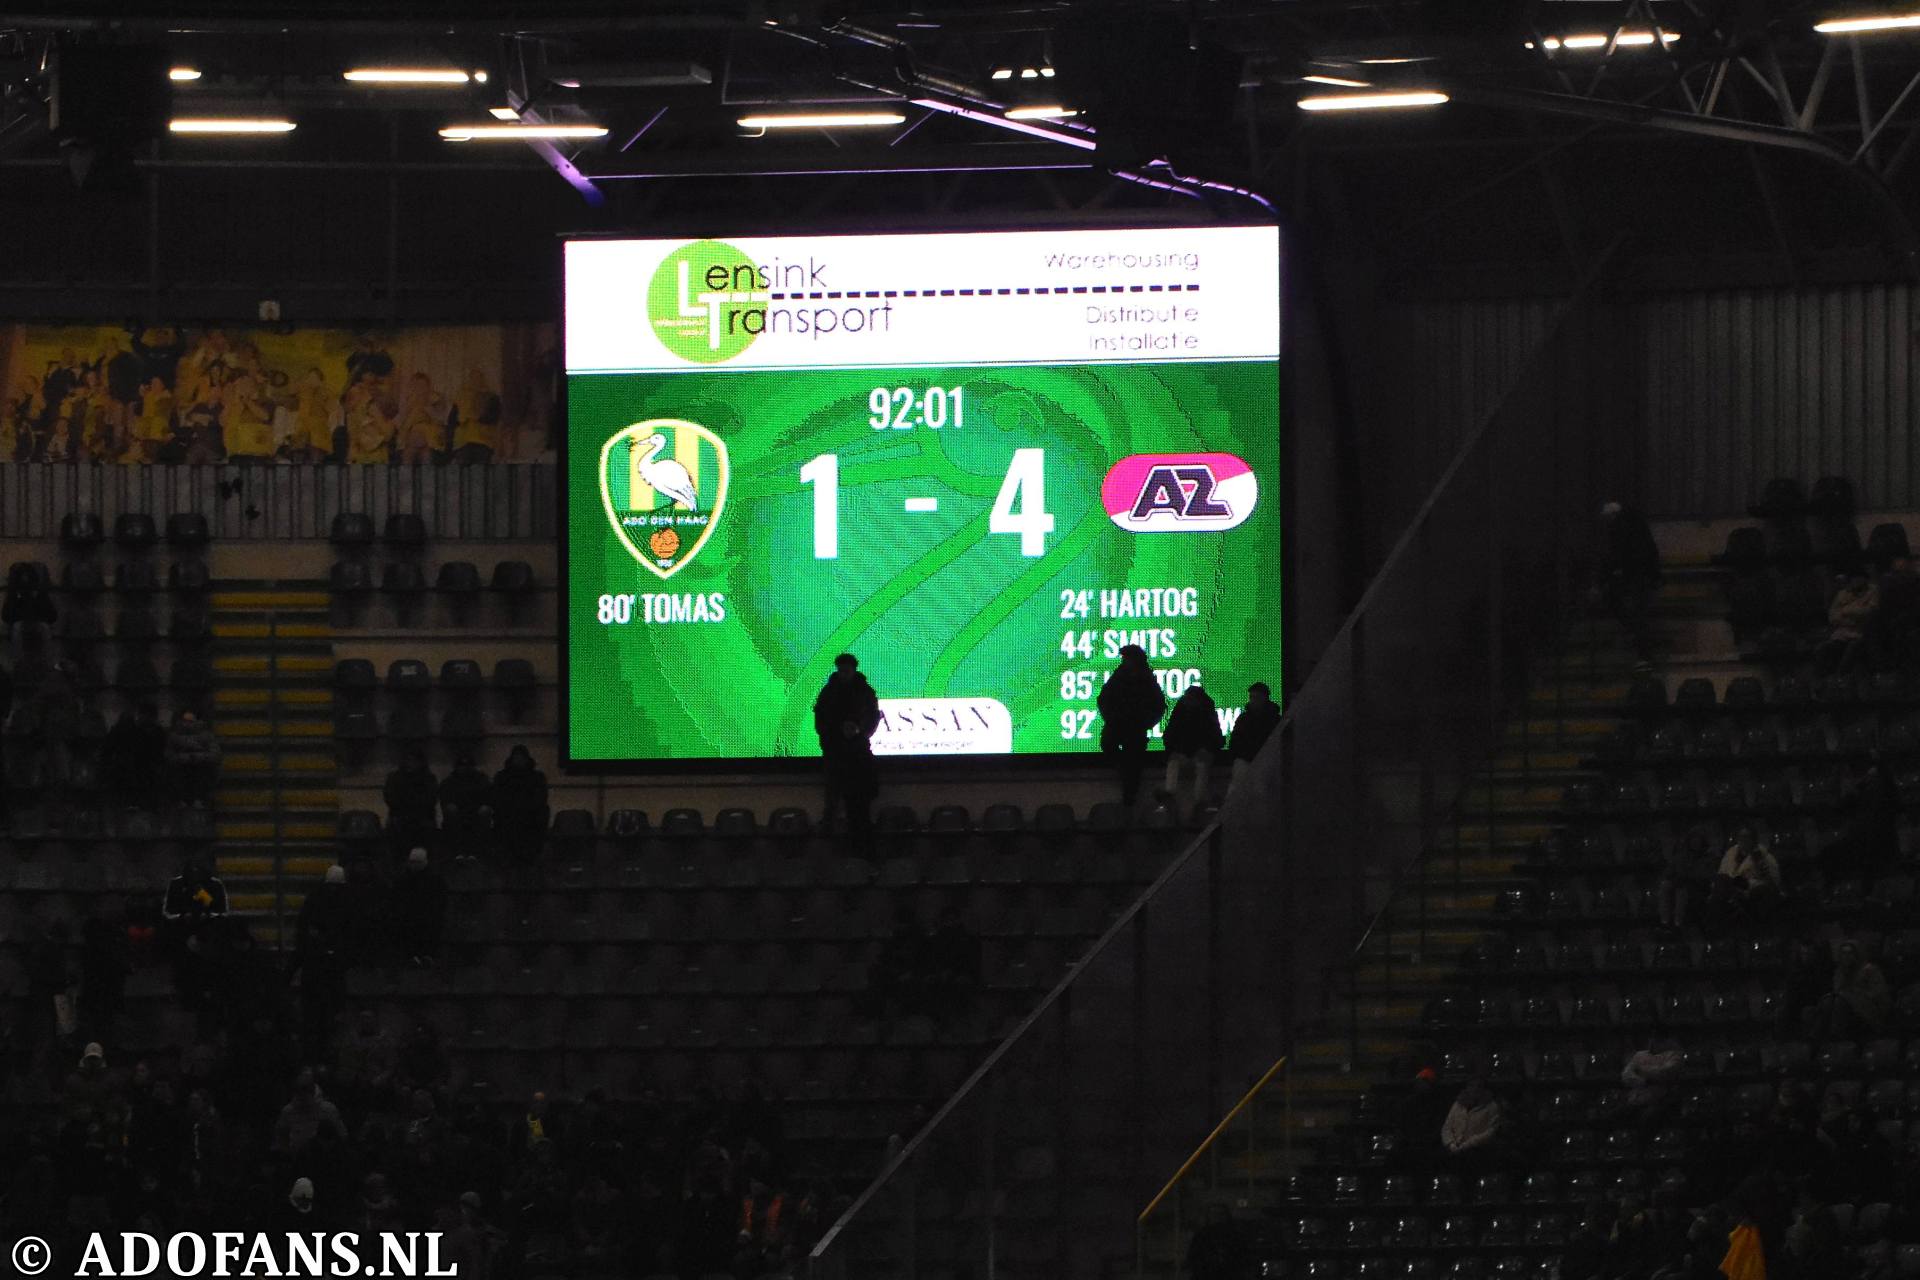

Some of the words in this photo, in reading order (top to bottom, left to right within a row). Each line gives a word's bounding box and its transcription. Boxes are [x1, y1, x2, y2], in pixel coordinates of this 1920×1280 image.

[1087, 305, 1198, 323] Distribute
[1090, 333, 1198, 350] Installate
[869, 386, 963, 430] 92:01
[800, 454, 838, 559] 1
[989, 448, 1054, 557] 4
[1128, 464, 1233, 520] AZ
[641, 593, 725, 623] TOMAS
[1101, 587, 1198, 617] HARTOG
